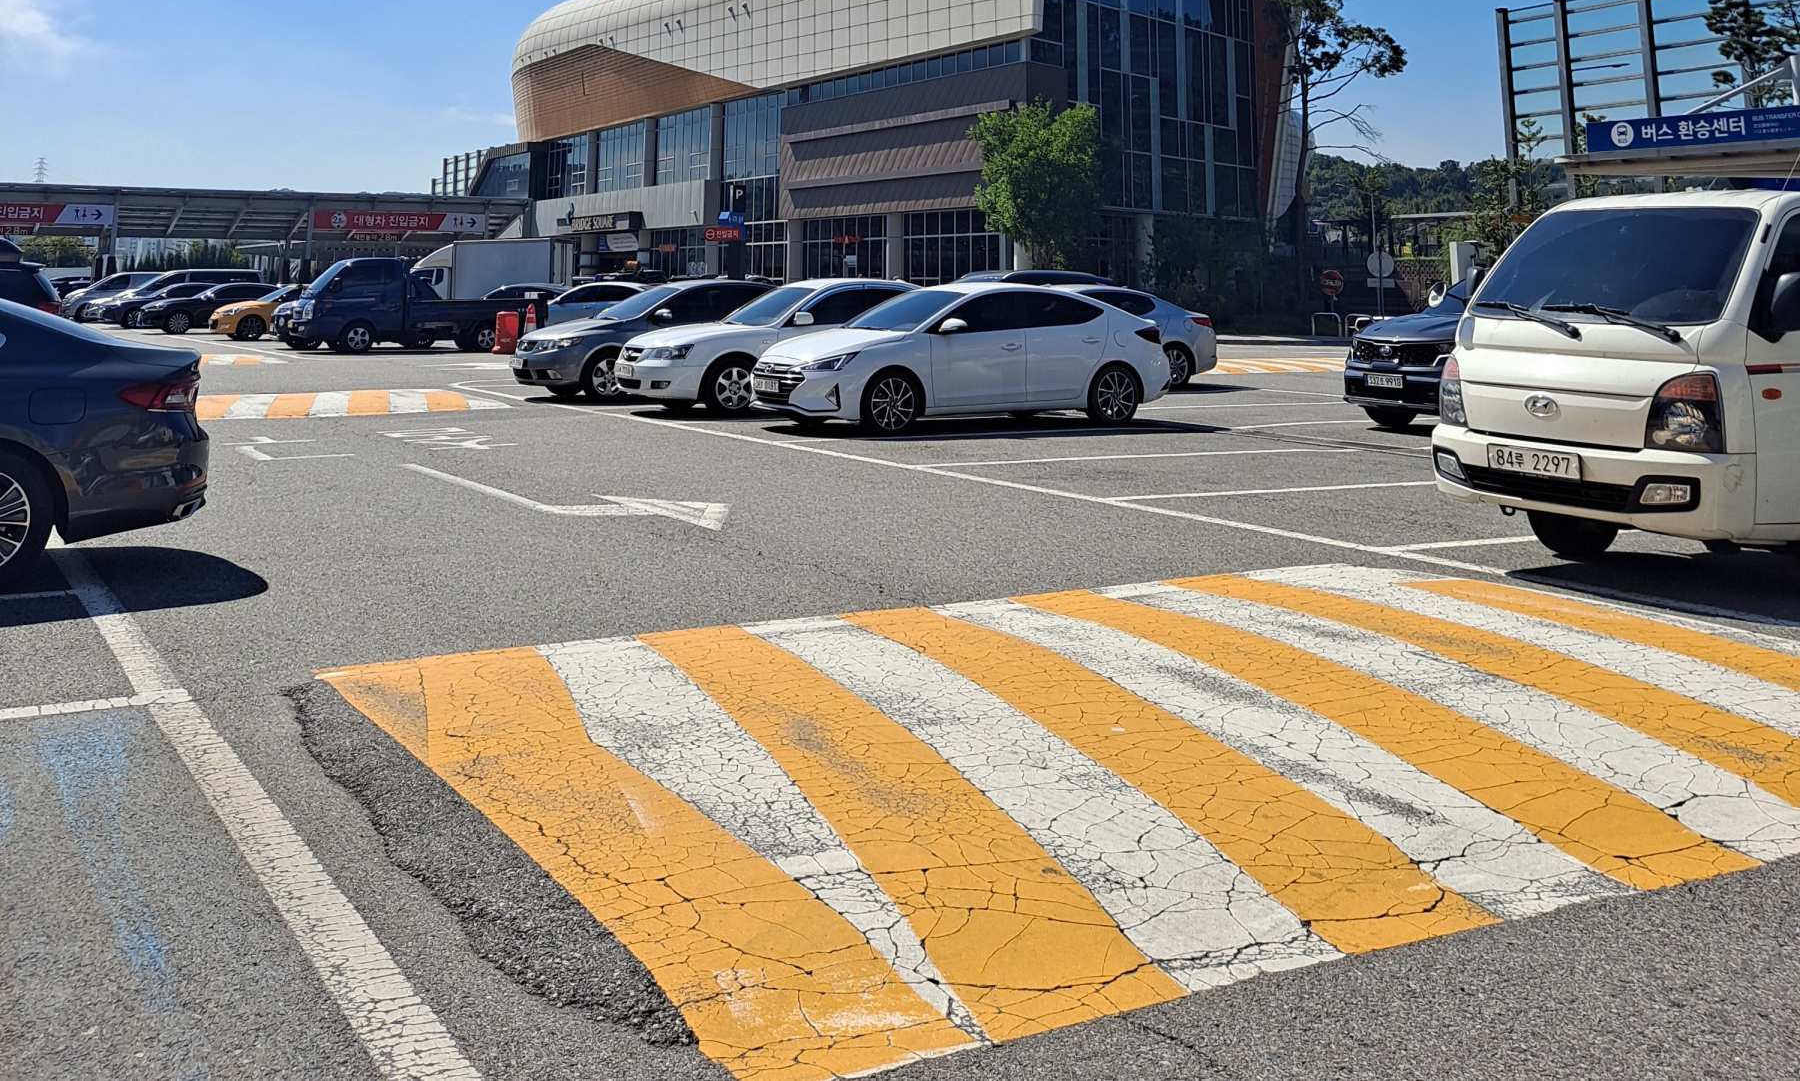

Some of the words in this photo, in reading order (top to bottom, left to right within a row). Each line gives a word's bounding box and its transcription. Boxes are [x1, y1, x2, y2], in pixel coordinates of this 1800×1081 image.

[1641, 122, 1674, 142] 버스
[1678, 115, 1746, 139] 환승센터
[735, 189, 744, 199] P
[353, 214, 385, 228] 대형차
[388, 214, 429, 228] 진입금지
[571, 217, 592, 232] BRIDGE
[592, 215, 615, 230] SQUARE
[1531, 453, 1570, 475] 2297
